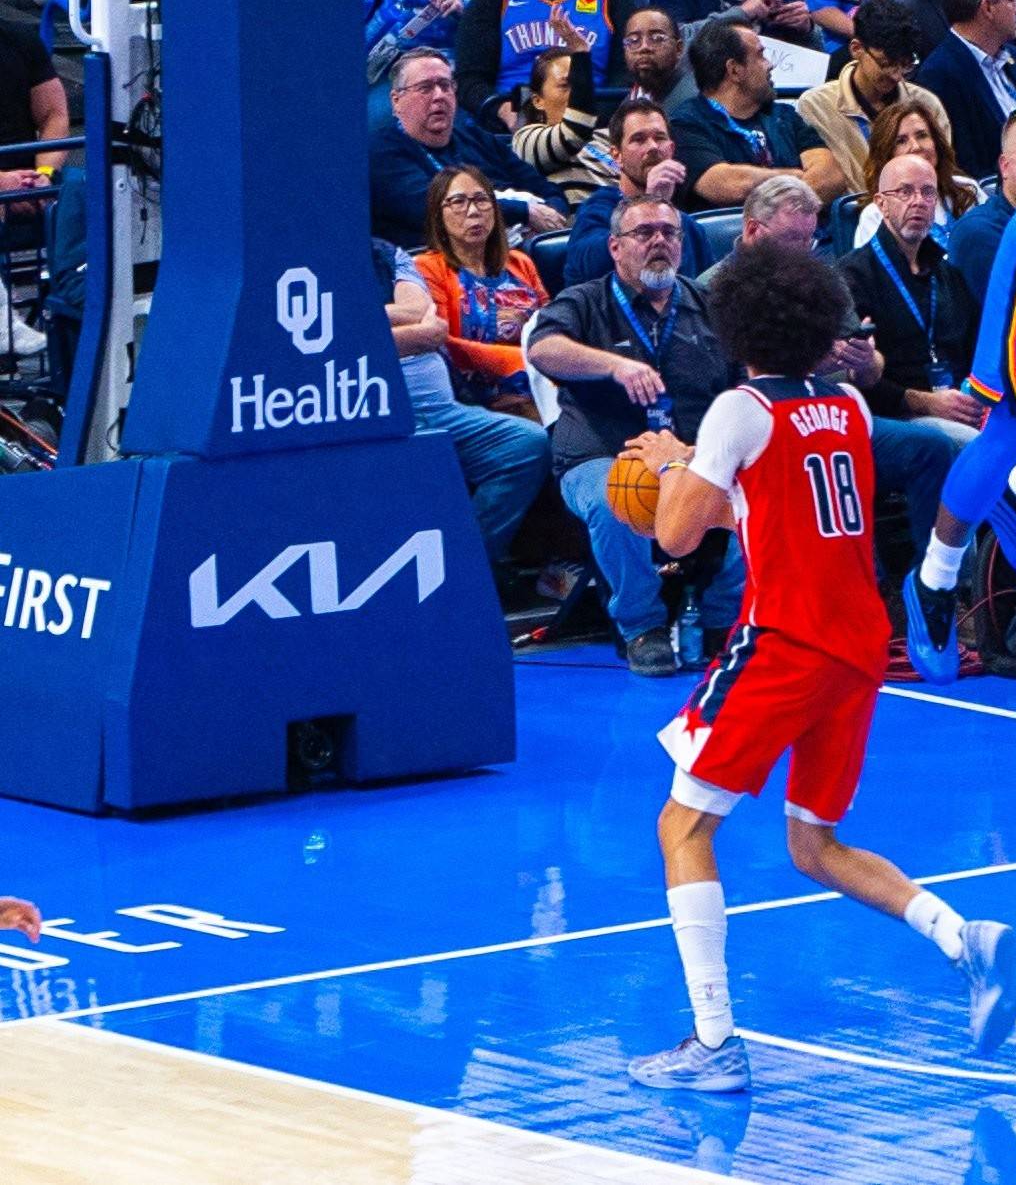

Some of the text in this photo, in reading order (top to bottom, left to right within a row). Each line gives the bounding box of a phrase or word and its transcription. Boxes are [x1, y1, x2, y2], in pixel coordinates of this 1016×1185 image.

[276, 267, 333, 355] OU
[230, 355, 391, 433] Health
[789, 403, 849, 437] GEORGE
[803, 451, 865, 538] 18
